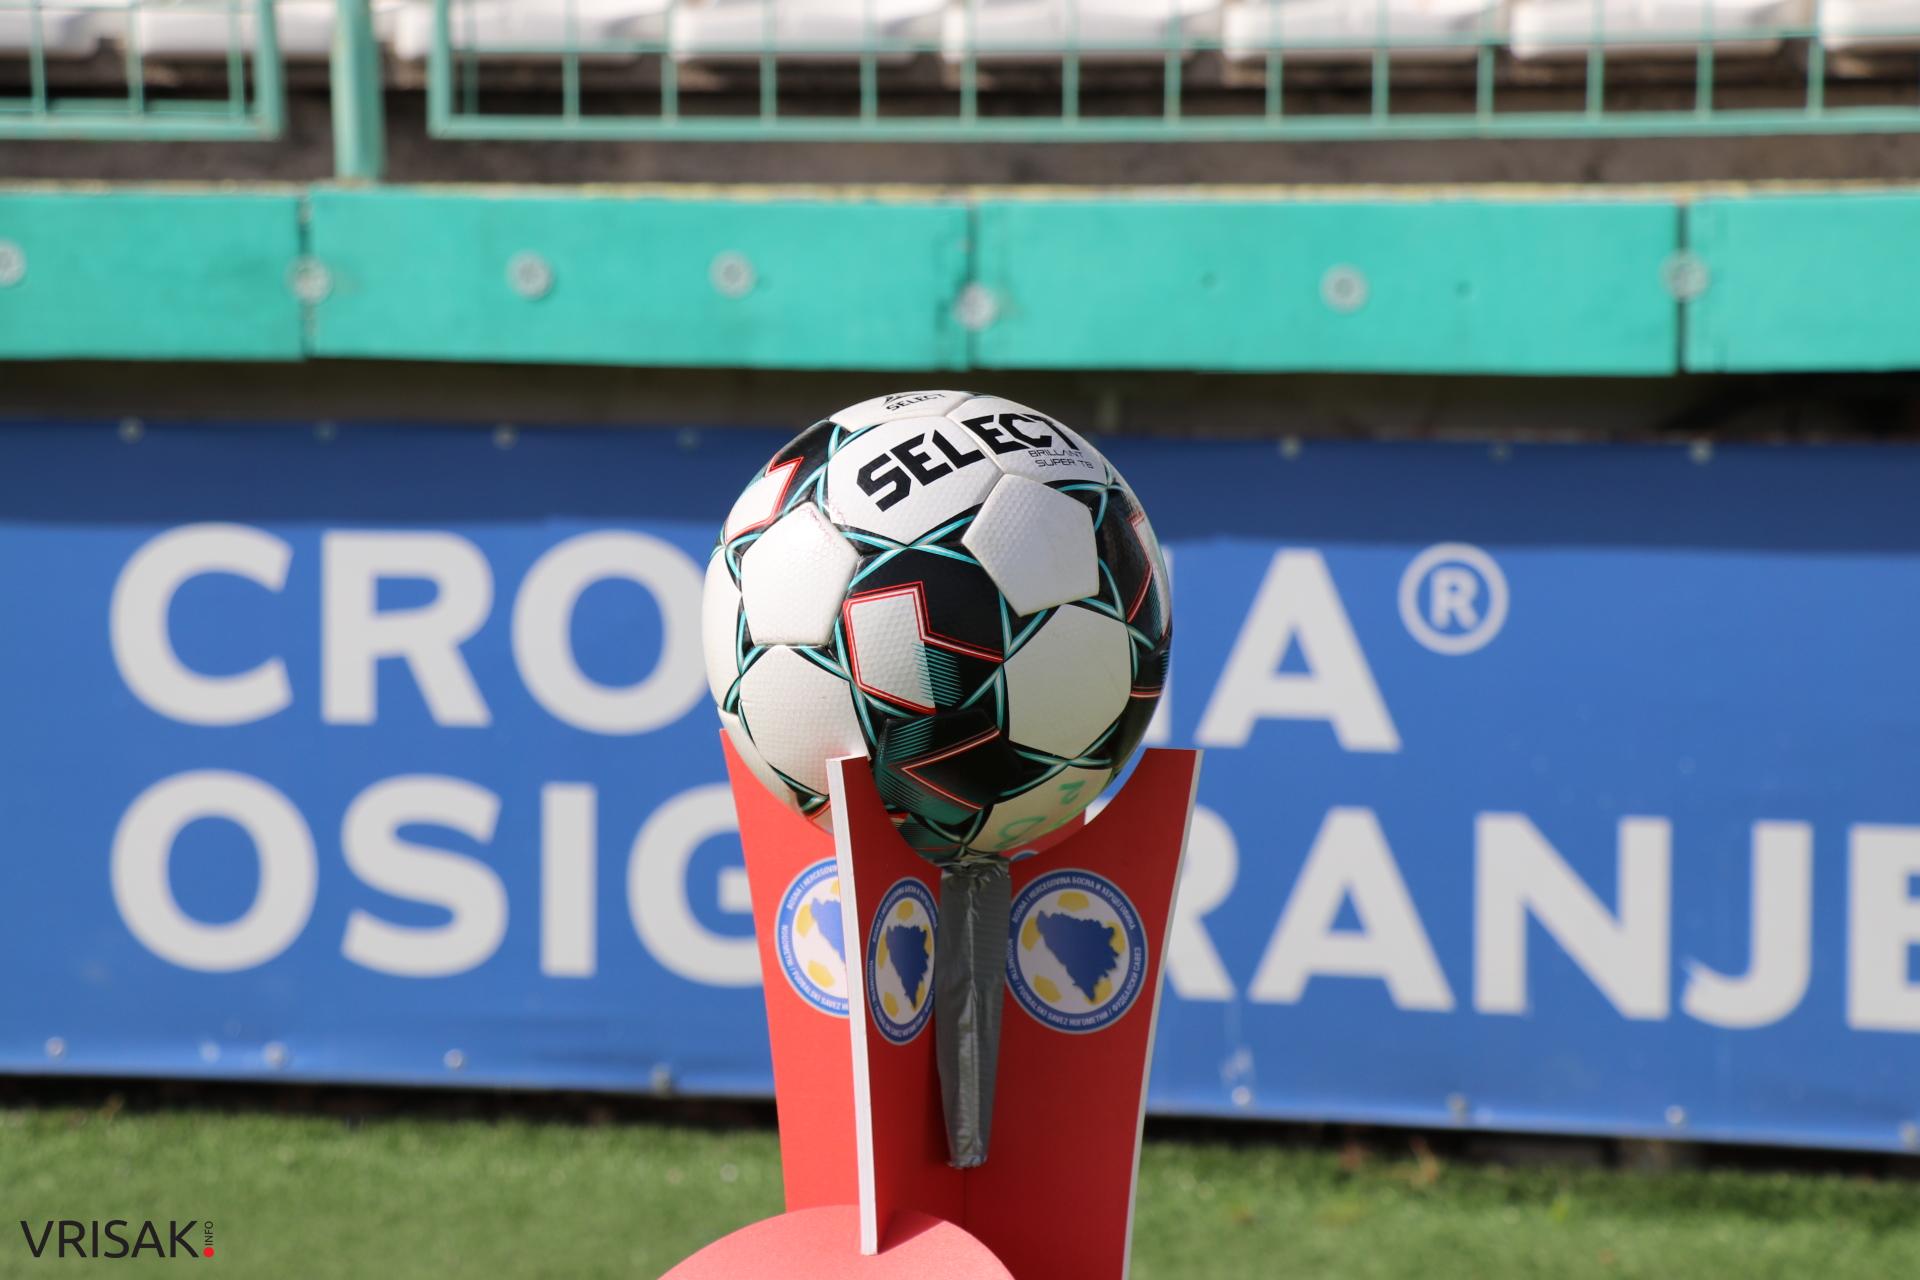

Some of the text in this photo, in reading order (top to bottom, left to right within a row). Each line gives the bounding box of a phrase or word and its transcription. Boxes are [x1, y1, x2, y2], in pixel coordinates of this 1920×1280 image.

[886, 393, 946, 411] SELECT
[1028, 449, 1083, 458] BRILLANT
[856, 413, 1080, 513] SELECT
[1035, 459, 1075, 468] SUPER
